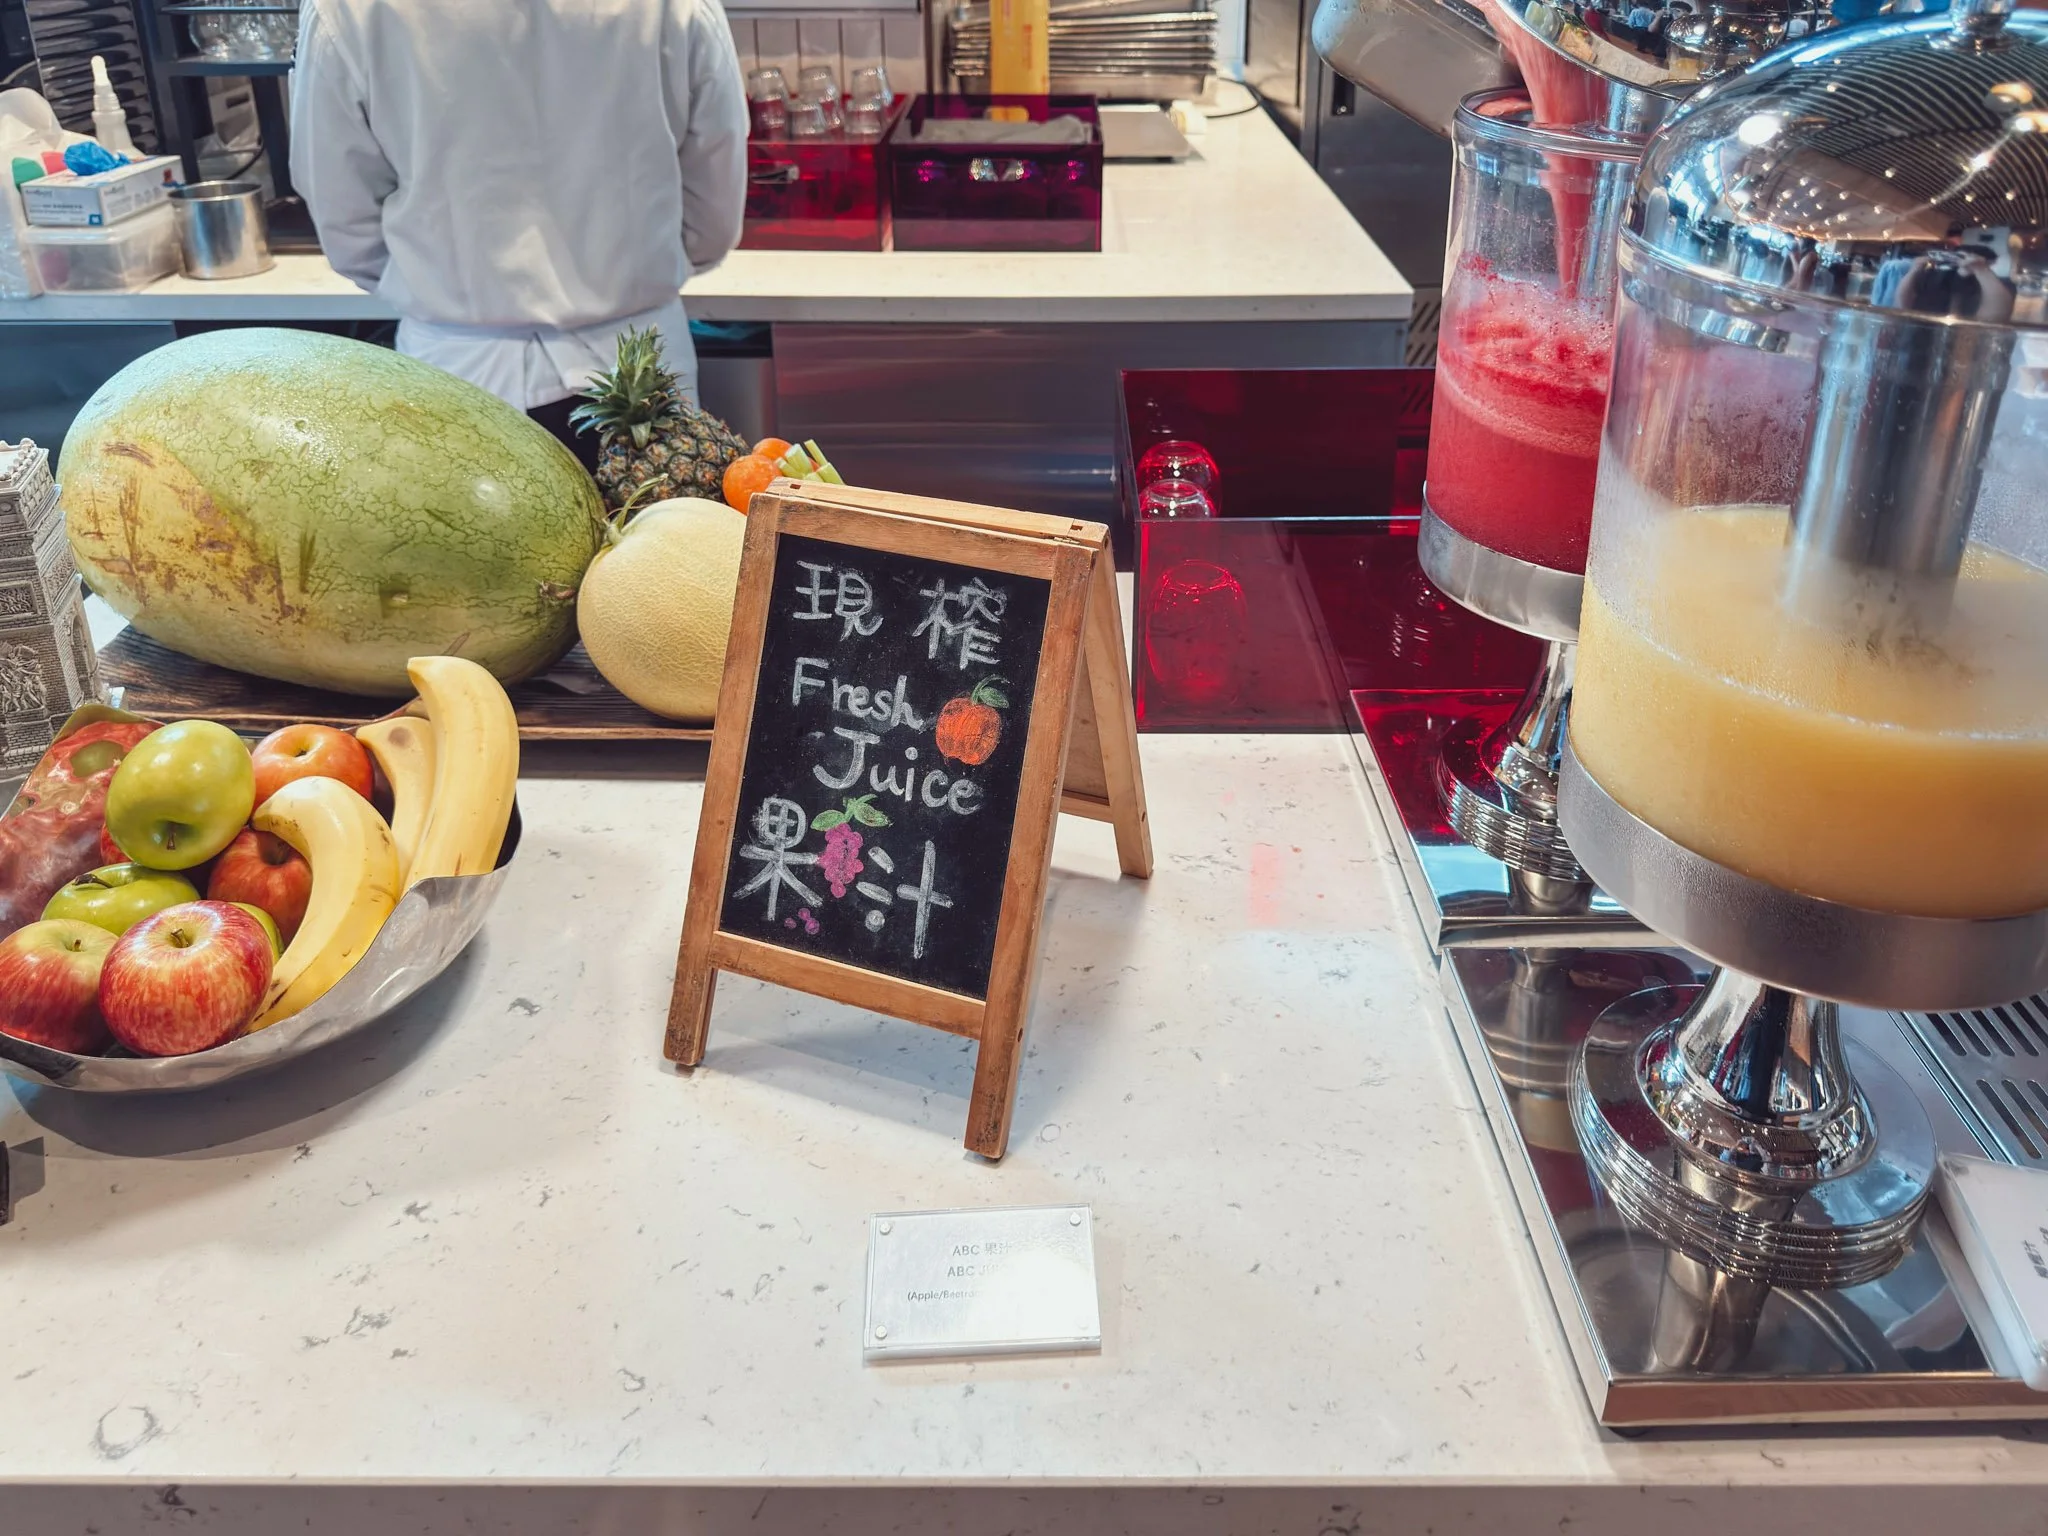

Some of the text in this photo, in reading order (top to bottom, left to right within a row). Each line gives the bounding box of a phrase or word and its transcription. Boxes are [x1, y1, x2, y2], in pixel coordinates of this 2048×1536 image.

[792, 657, 925, 732] Fresh
[812, 727, 984, 816] Juice
[947, 1265, 975, 1278] ABC
[952, 1245, 980, 1257] ABC
